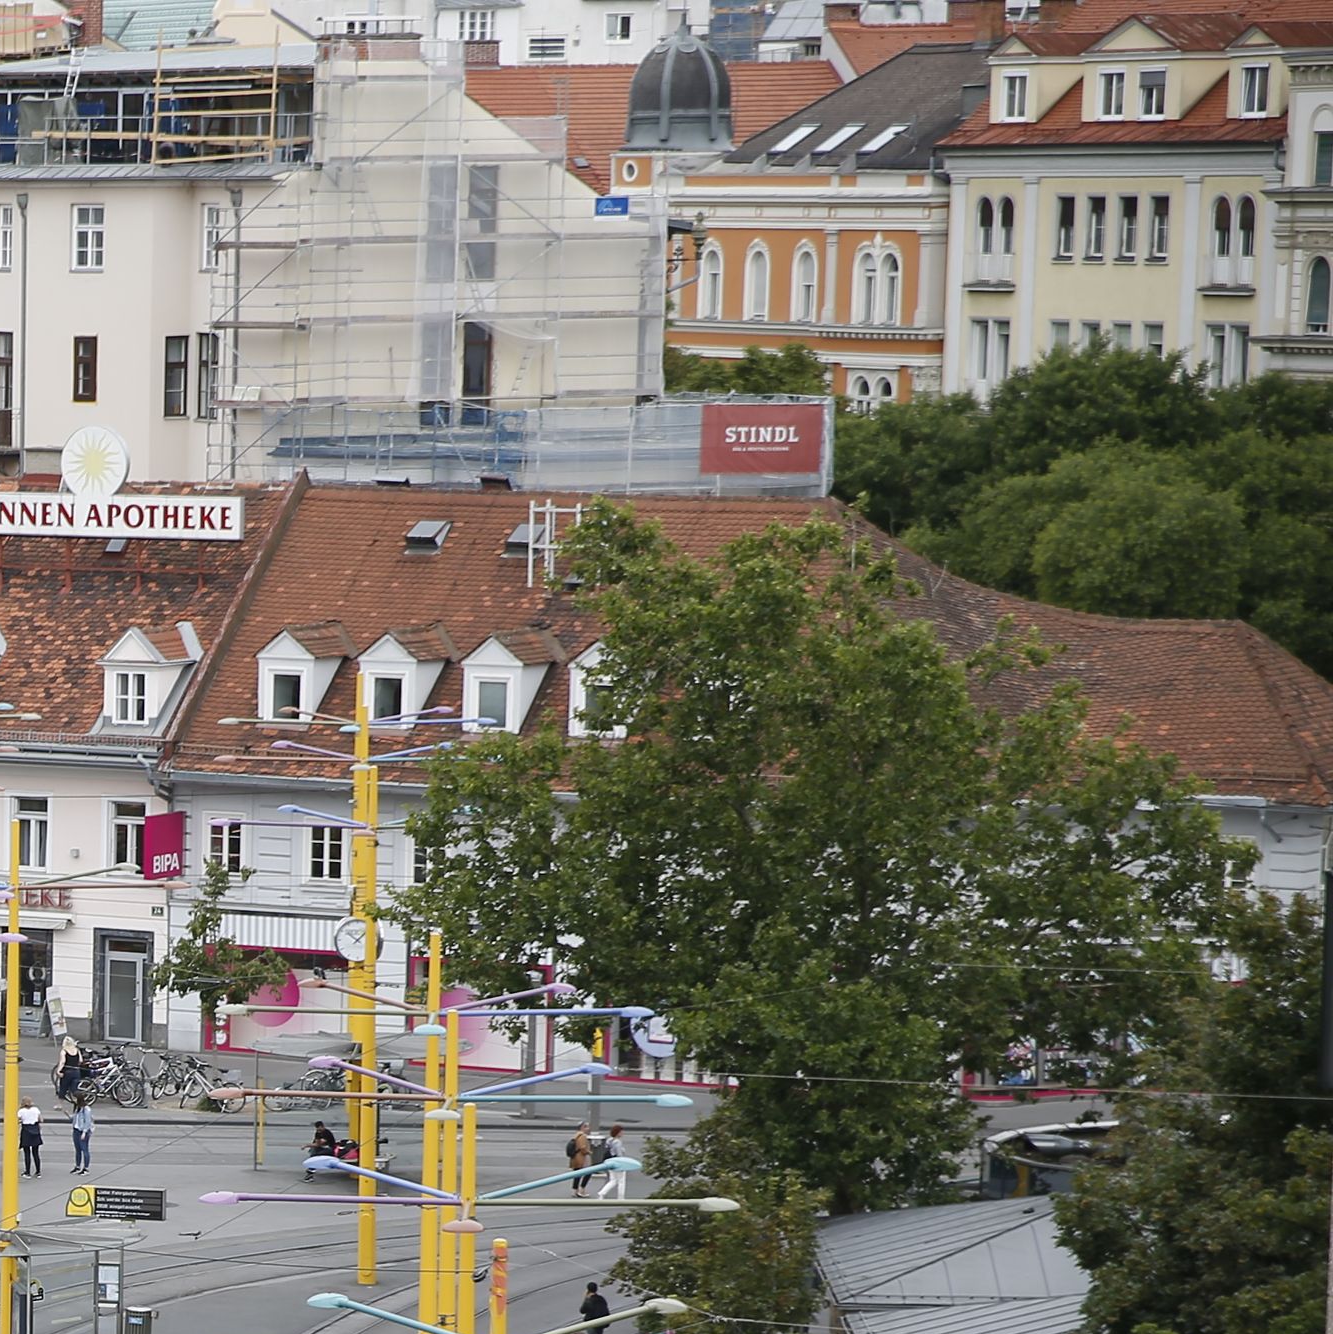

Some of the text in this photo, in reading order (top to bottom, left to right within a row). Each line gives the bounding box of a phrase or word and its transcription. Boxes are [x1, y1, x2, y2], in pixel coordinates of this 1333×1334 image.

[725, 426, 799, 443] STINDL
[84, 503, 233, 530] APOTHEKE
[153, 853, 180, 874] BIPA
